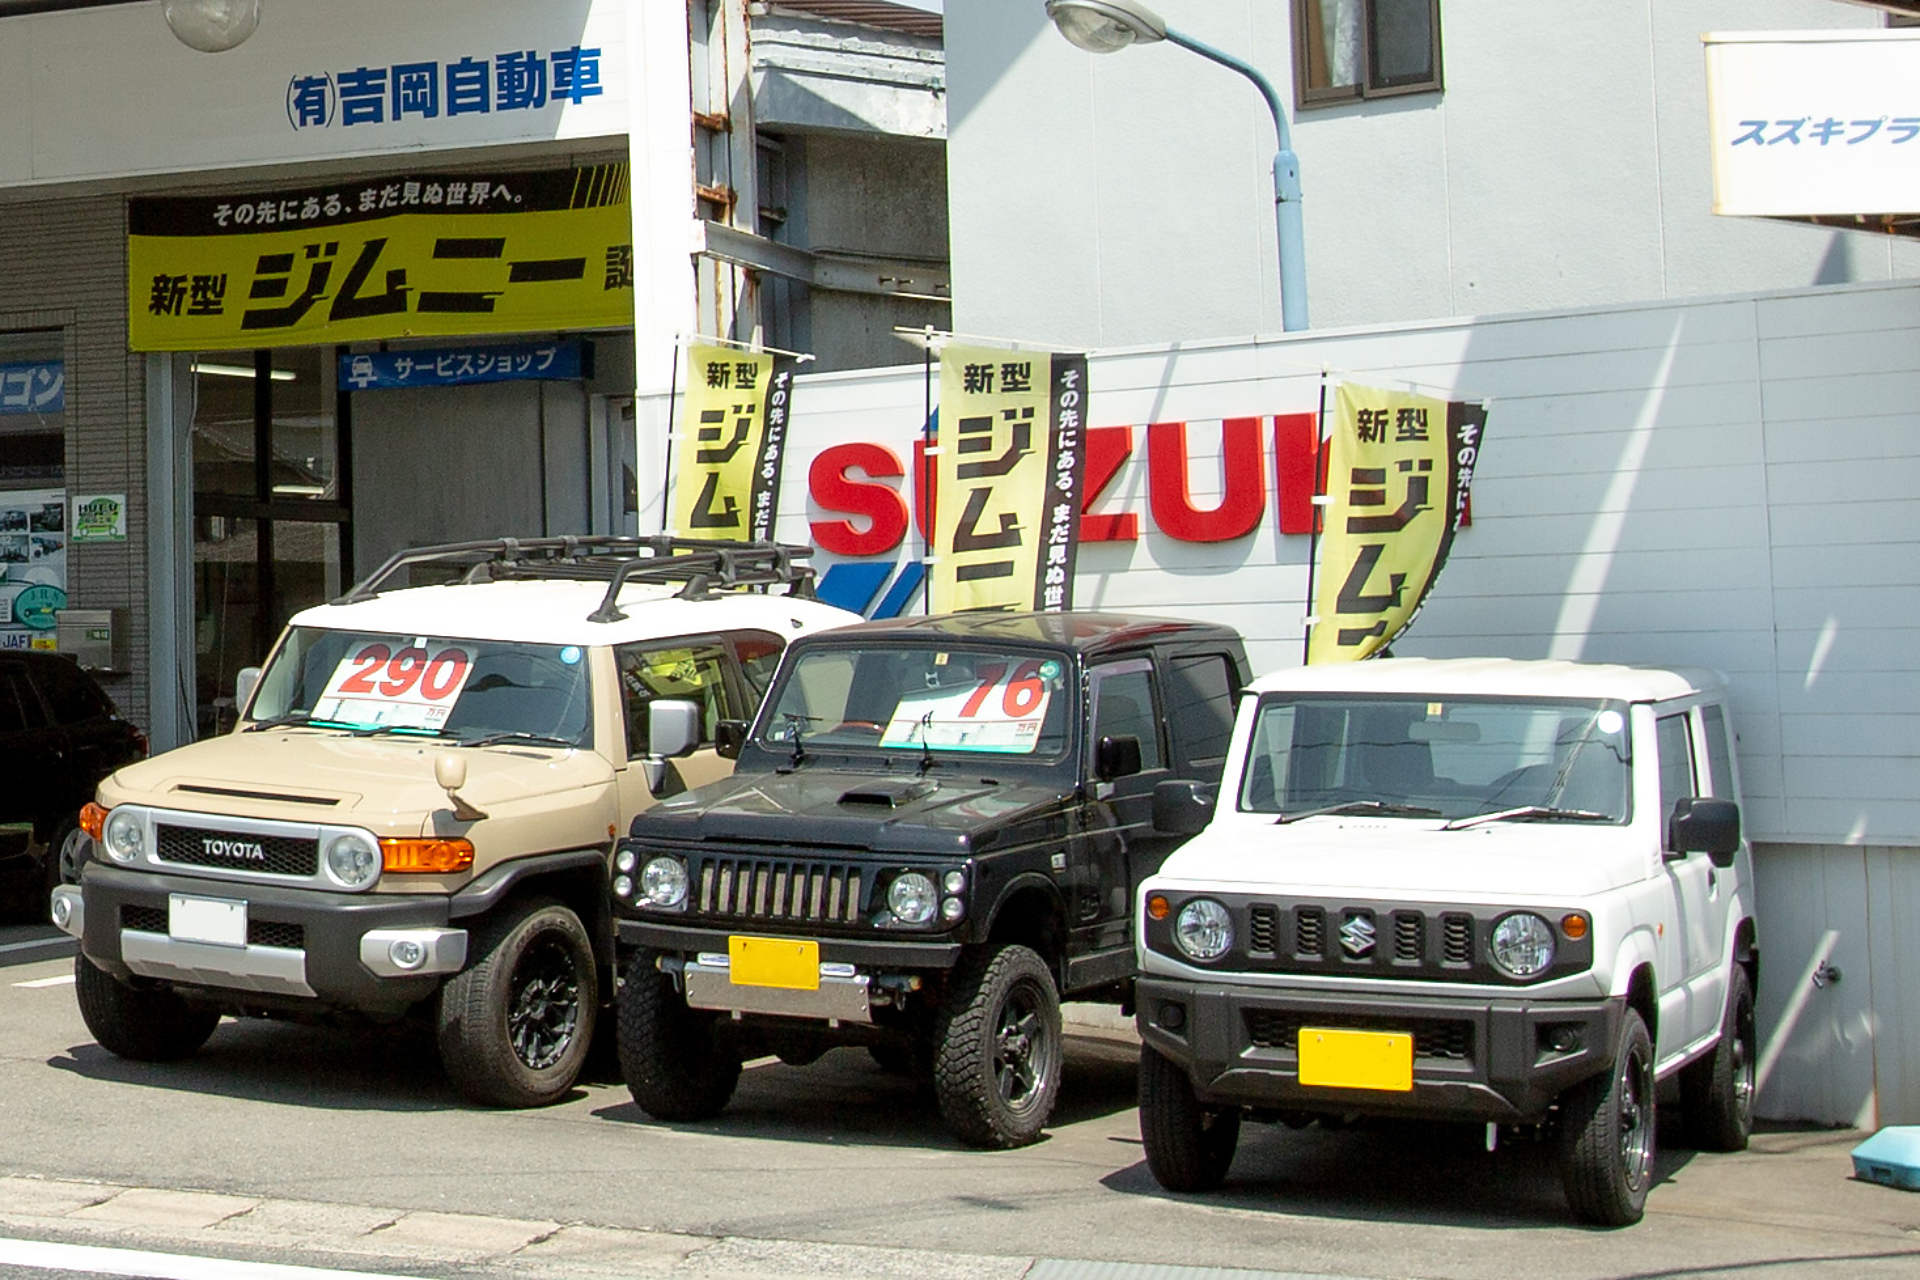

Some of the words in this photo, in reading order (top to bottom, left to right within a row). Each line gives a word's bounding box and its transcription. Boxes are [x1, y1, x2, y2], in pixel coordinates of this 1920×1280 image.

[213, 181, 524, 227] その先にある、まだ見ぬ世界へ。
[394, 349, 557, 380] サービスショップ
[707, 362, 758, 390] 新型
[964, 362, 1032, 394] 新型
[1357, 408, 1430, 443] 新型
[337, 643, 469, 701] 290
[958, 659, 1044, 718] 76
[203, 839, 264, 860] TOYOTA
